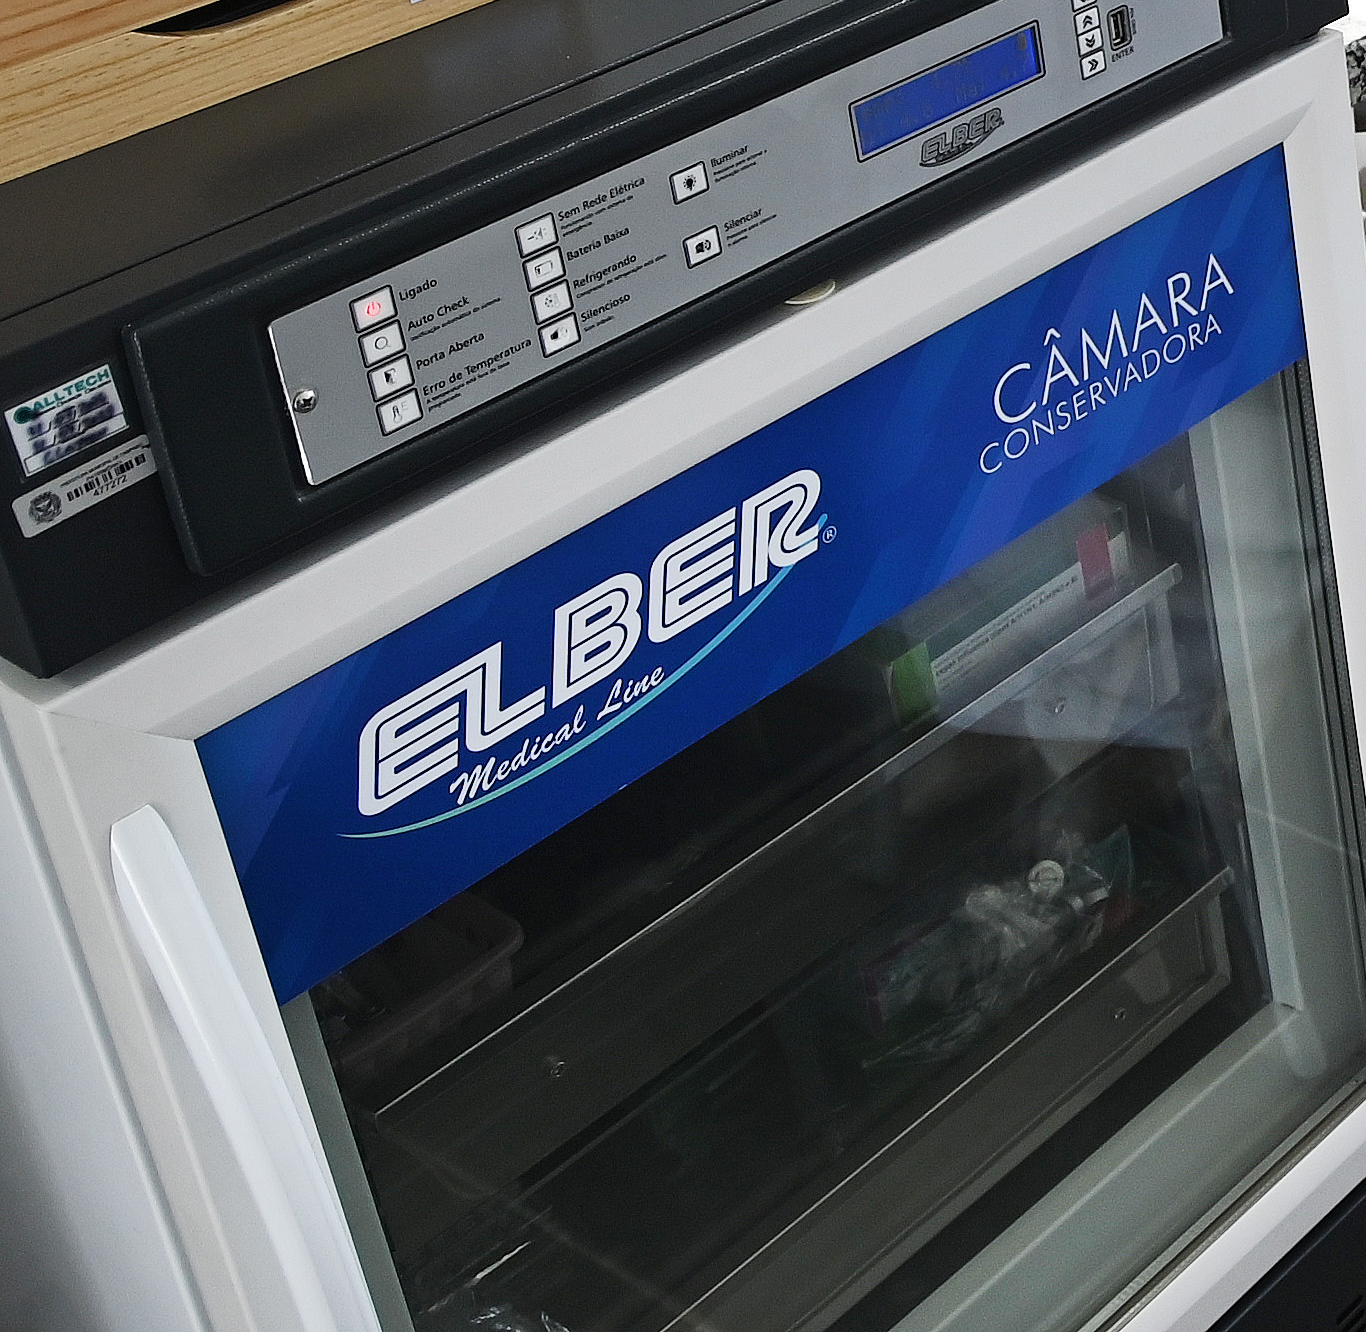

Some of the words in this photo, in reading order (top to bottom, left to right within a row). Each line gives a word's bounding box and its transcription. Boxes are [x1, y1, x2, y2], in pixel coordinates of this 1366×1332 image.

[921, 107, 1003, 163] ELBER
[723, 208, 763, 232] Silenciar
[566, 239, 602, 262] Bateria
[603, 226, 631, 246] Baixa
[399, 278, 438, 302] Ligado
[572, 254, 638, 290] Refrigerando
[407, 313, 435, 332] Auto
[436, 295, 470, 317] Check
[580, 293, 631, 323] Silencioso
[415, 351, 446, 371] Porta
[448, 332, 486, 356] Aberta
[993, 252, 1235, 424] CÂMARA
[422, 380, 447, 396] Erro
[448, 371, 463, 384] de
[464, 338, 533, 375] Temperatura
[31, 369, 111, 413] ALLTECH
[979, 313, 1223, 474] CONSERVADORA
[358, 468, 822, 816] ELBER
[449, 704, 587, 807] Medical
[596, 666, 666, 721] Line
